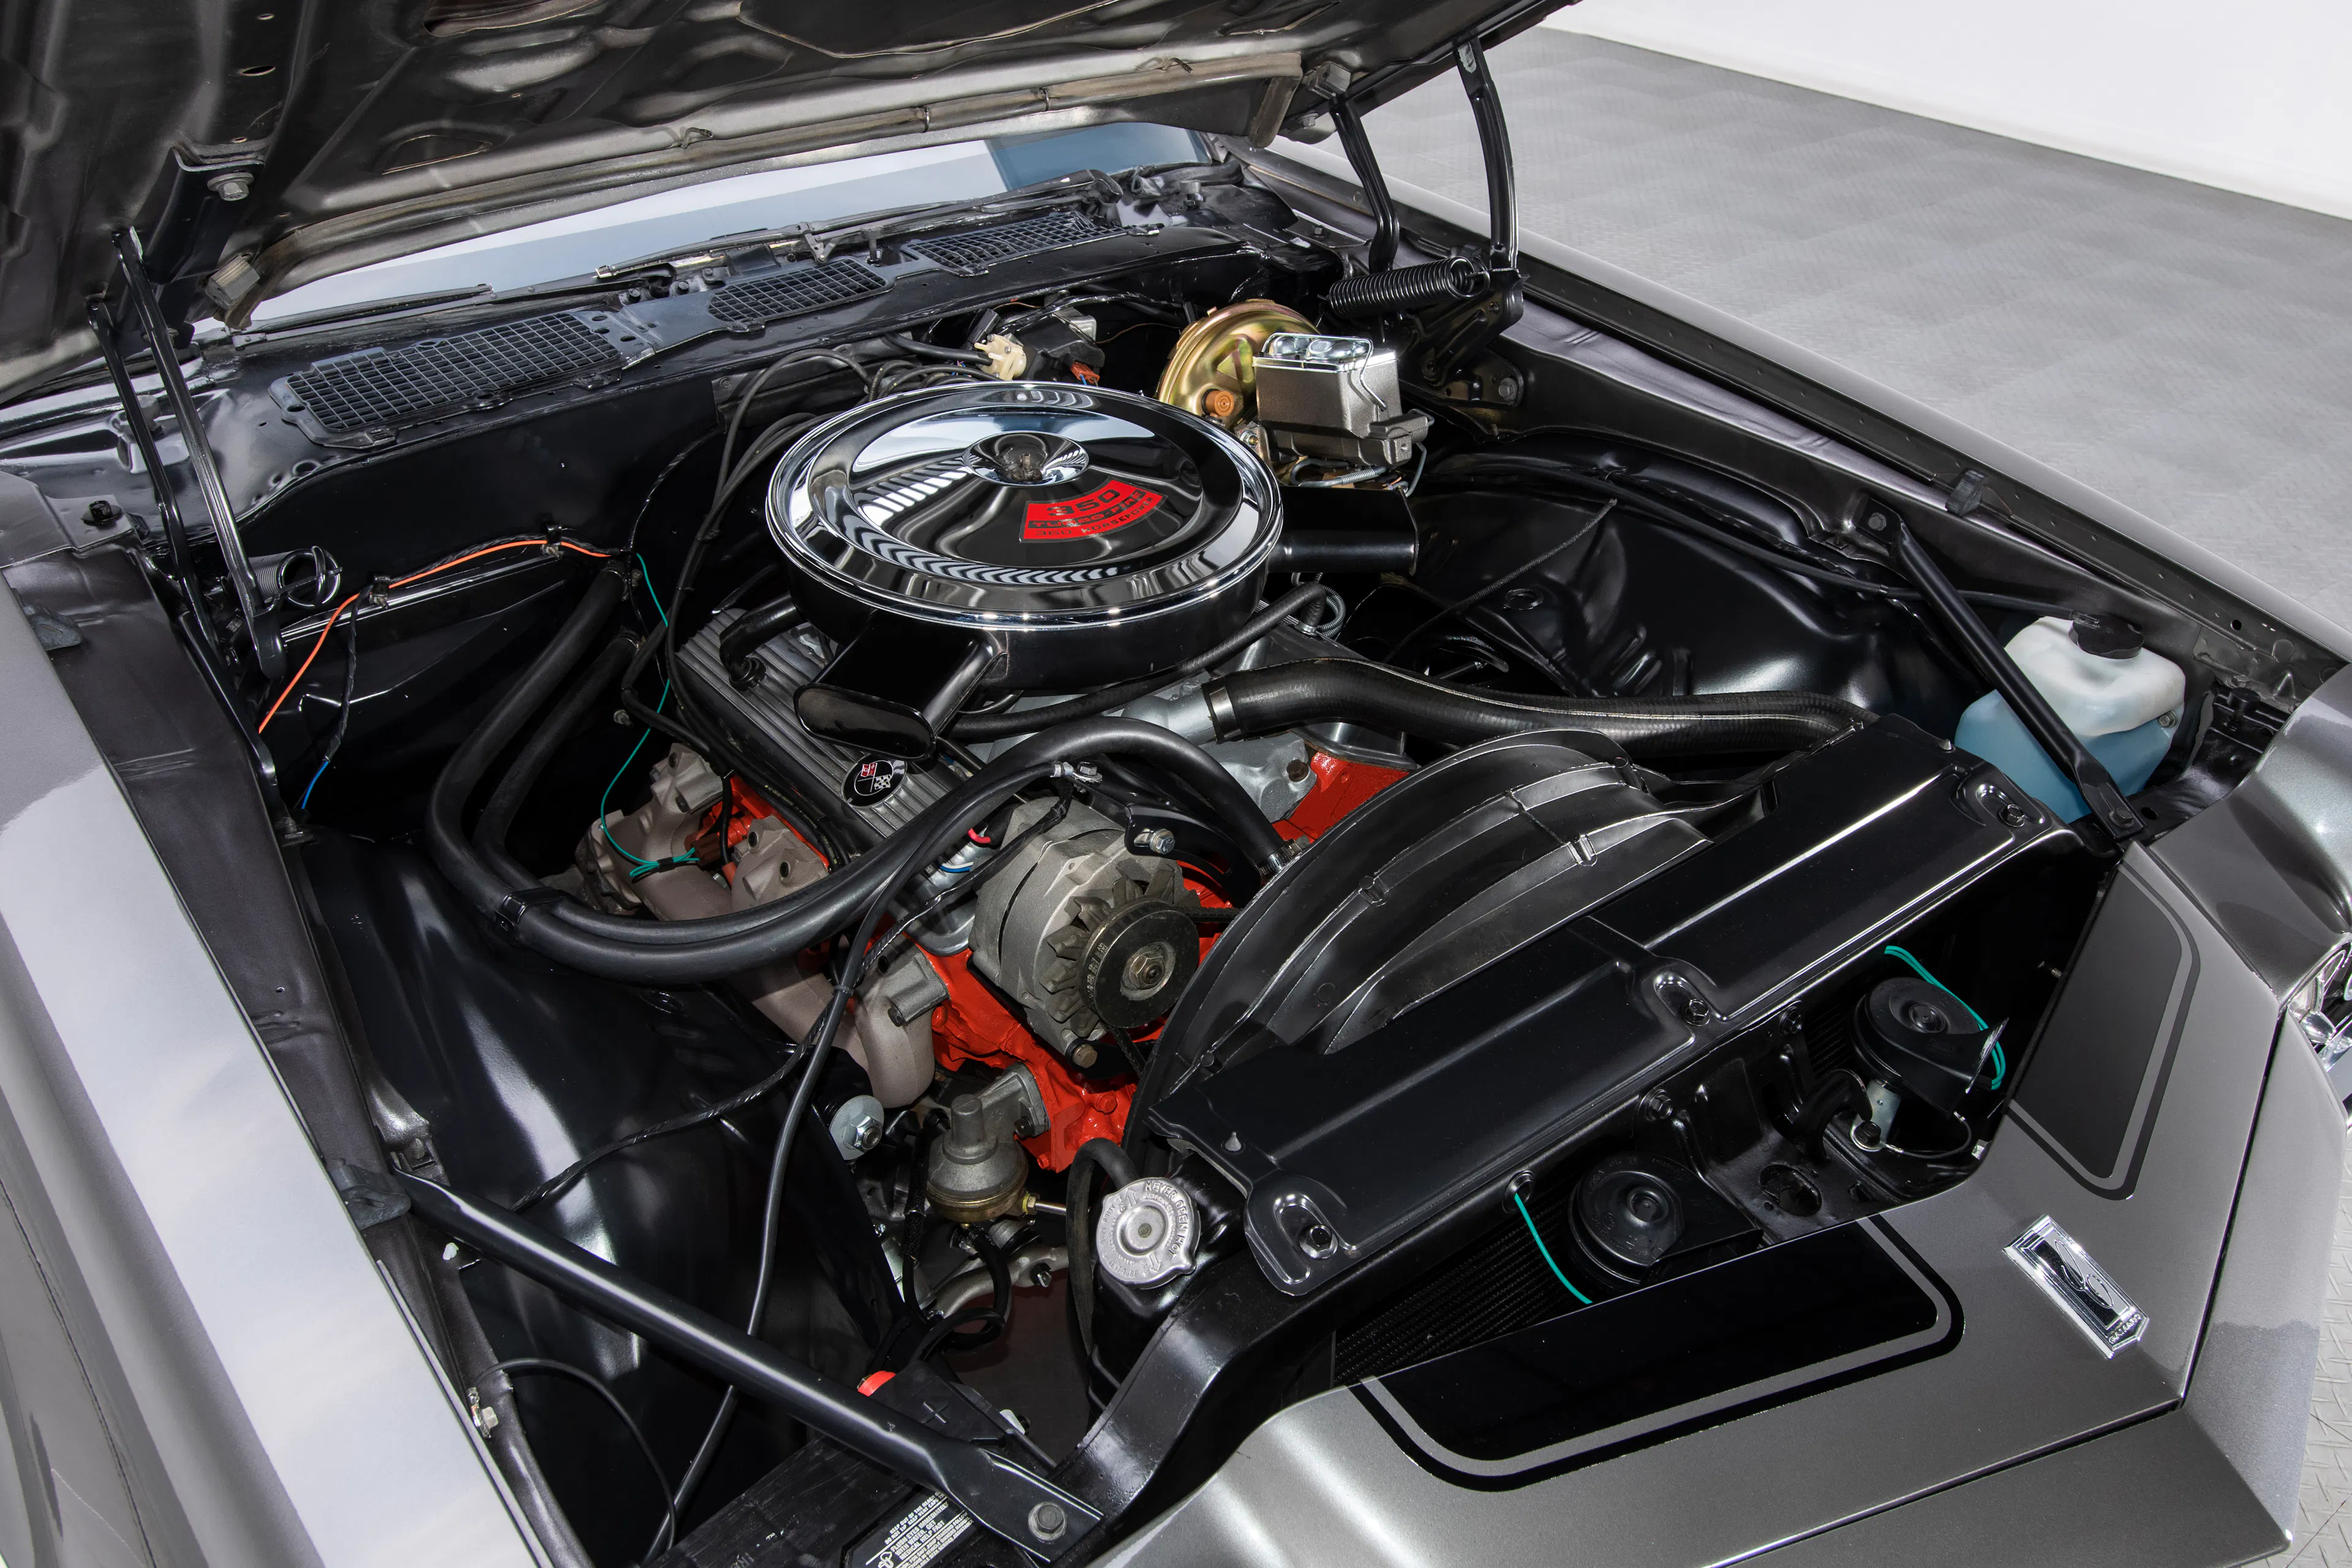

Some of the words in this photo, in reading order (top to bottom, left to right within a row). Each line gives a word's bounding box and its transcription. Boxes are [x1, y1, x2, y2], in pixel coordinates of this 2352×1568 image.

[1032, 491, 1142, 527] TURBO-FIRE
[1047, 489, 1121, 516] 350
[1082, 497, 1154, 533] HORSEPOWER
[1145, 1181, 1177, 1201] NEVER
[1175, 1199, 1188, 1229] OPEN
[1169, 1234, 1185, 1260] HOT
[1123, 1268, 1138, 1277] TUBE
[2108, 1313, 2143, 1344] CAMARO
[889, 1524, 900, 1534] KEEP
[900, 1517, 909, 1526] OUT
[914, 1506, 923, 1514] THE
[922, 1495, 935, 1508] REACH
[890, 1536, 908, 1553] FLUSH
[906, 1526, 920, 1540] EYES
[918, 1501, 949, 1529] IMMEDIATELY
[891, 1530, 900, 1539] NOT
[908, 1515, 918, 1526] KEEP
[918, 1507, 929, 1517] VENT
[928, 1498, 939, 1508] CAPS
[953, 1518, 974, 1539] ASSISTANCE
[894, 1543, 910, 1556] WITH
[907, 1529, 927, 1546] WATER.
[925, 1520, 937, 1531] GET
[899, 1541, 922, 1561] MEDICAL
[919, 1530, 933, 1544] HELP
[932, 1520, 945, 1532] FAST
[909, 1555, 918, 1564] FOR
[926, 1538, 937, 1550] JUMP
[936, 1524, 954, 1540] STARTING
[952, 1512, 968, 1526] FOLLOW
[925, 1541, 941, 1556] VEHICLE
